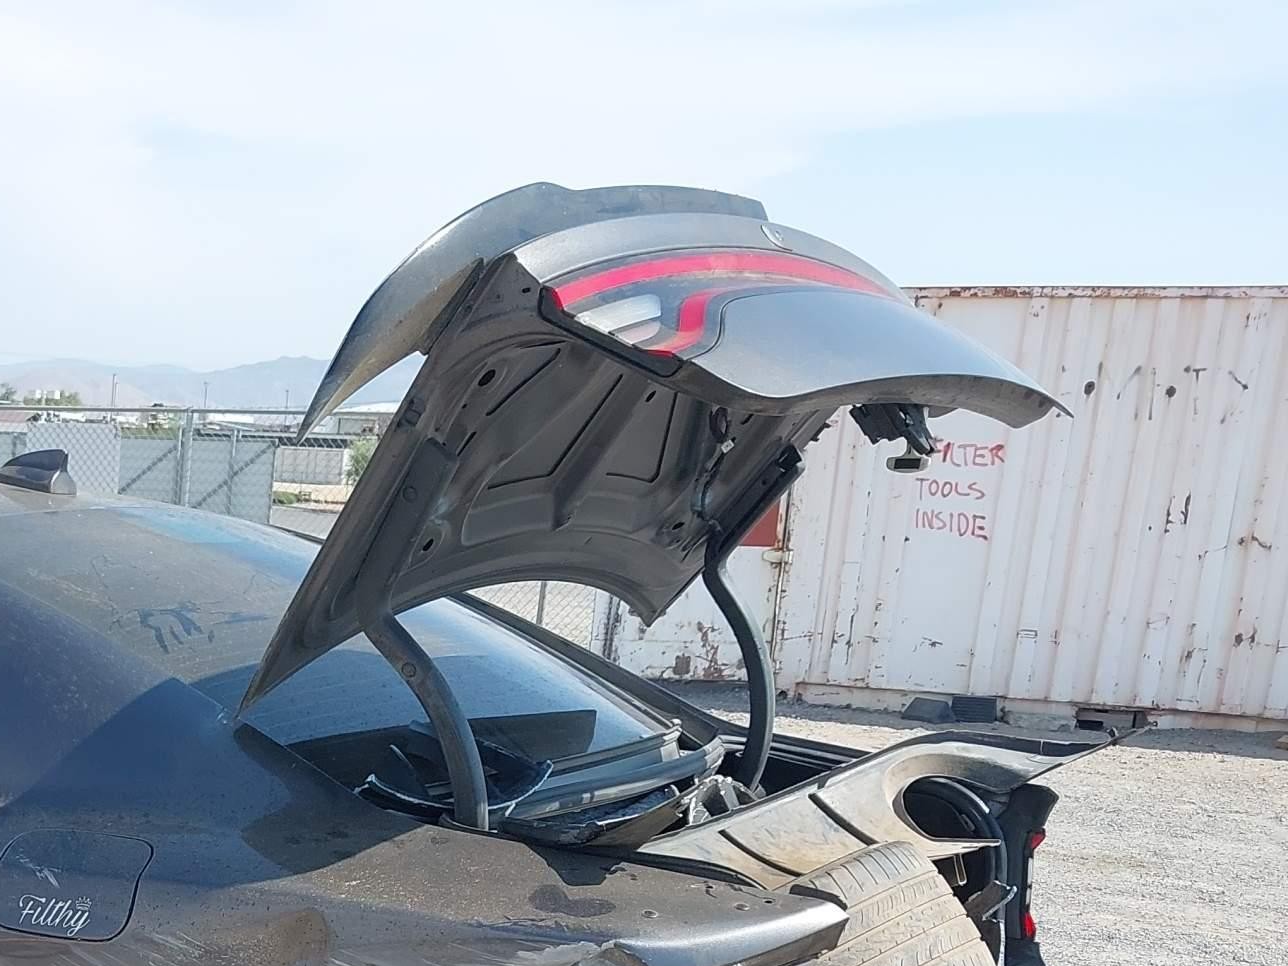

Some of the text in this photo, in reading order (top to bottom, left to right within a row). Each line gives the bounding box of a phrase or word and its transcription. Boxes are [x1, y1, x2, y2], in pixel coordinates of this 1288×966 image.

[915, 477, 986, 500] TOOLS
[915, 508, 988, 541] INSIDE
[19, 894, 90, 936] Filthy
